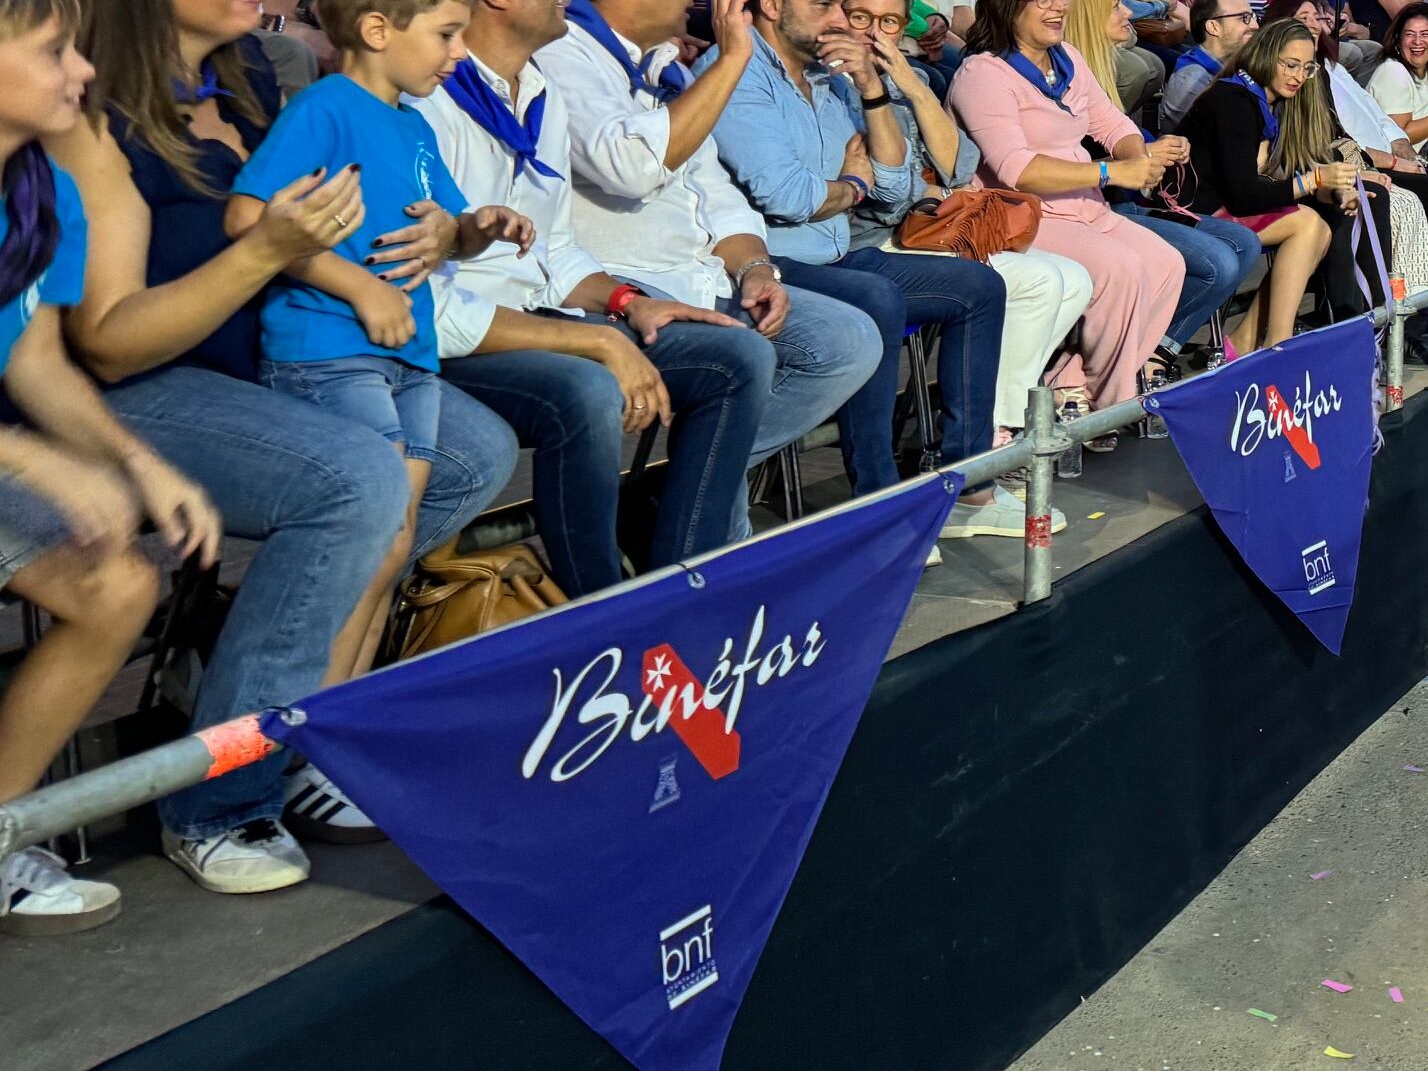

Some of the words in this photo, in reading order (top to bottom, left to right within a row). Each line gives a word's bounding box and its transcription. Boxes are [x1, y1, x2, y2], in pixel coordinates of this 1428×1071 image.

[1230, 369, 1343, 457] Binéfar
[1302, 546, 1331, 583] bnf
[521, 604, 828, 783] Binéfar
[661, 916, 714, 986] bnf
